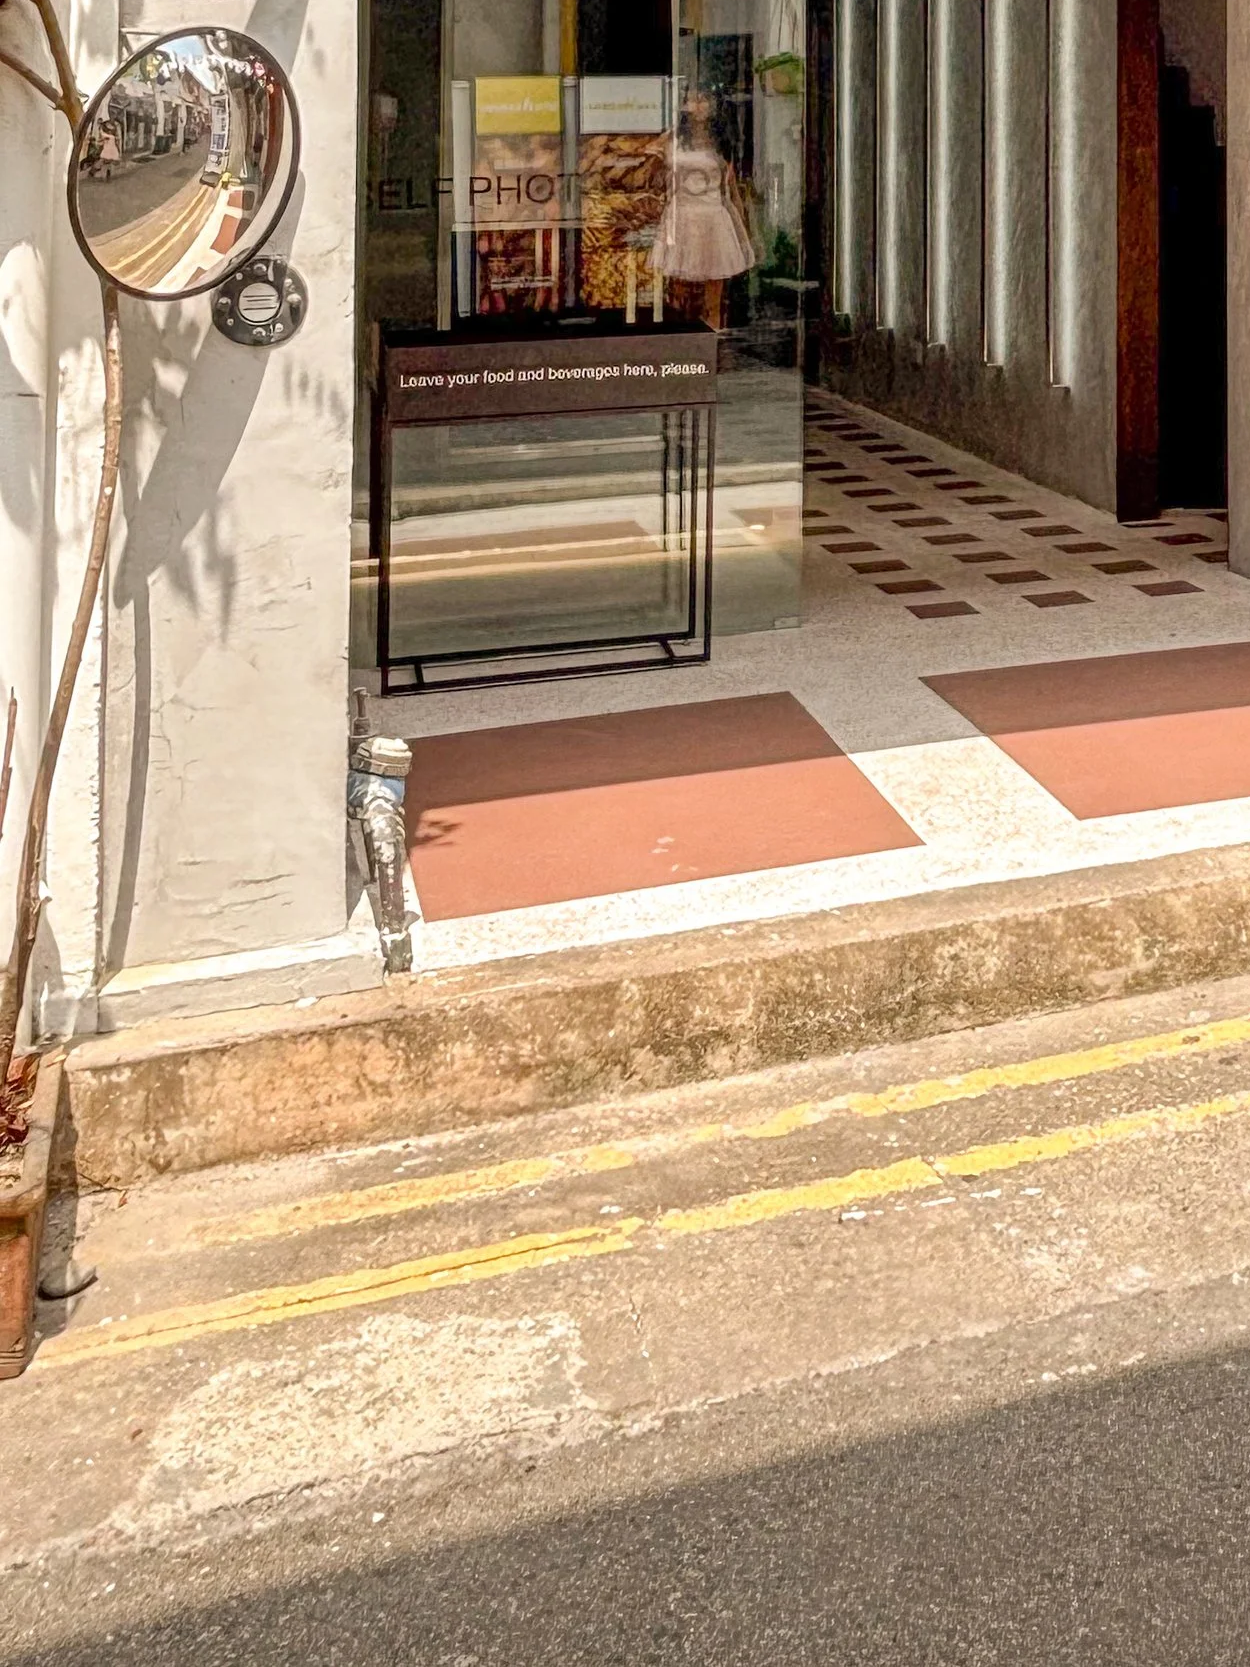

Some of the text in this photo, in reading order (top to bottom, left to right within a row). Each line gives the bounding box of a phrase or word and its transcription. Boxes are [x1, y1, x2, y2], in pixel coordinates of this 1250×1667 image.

[367, 176, 454, 210] ELF
[400, 374, 444, 388] Leave
[447, 374, 479, 388] your
[483, 370, 514, 383] food
[518, 368, 544, 381] and
[548, 367, 620, 380] beverages
